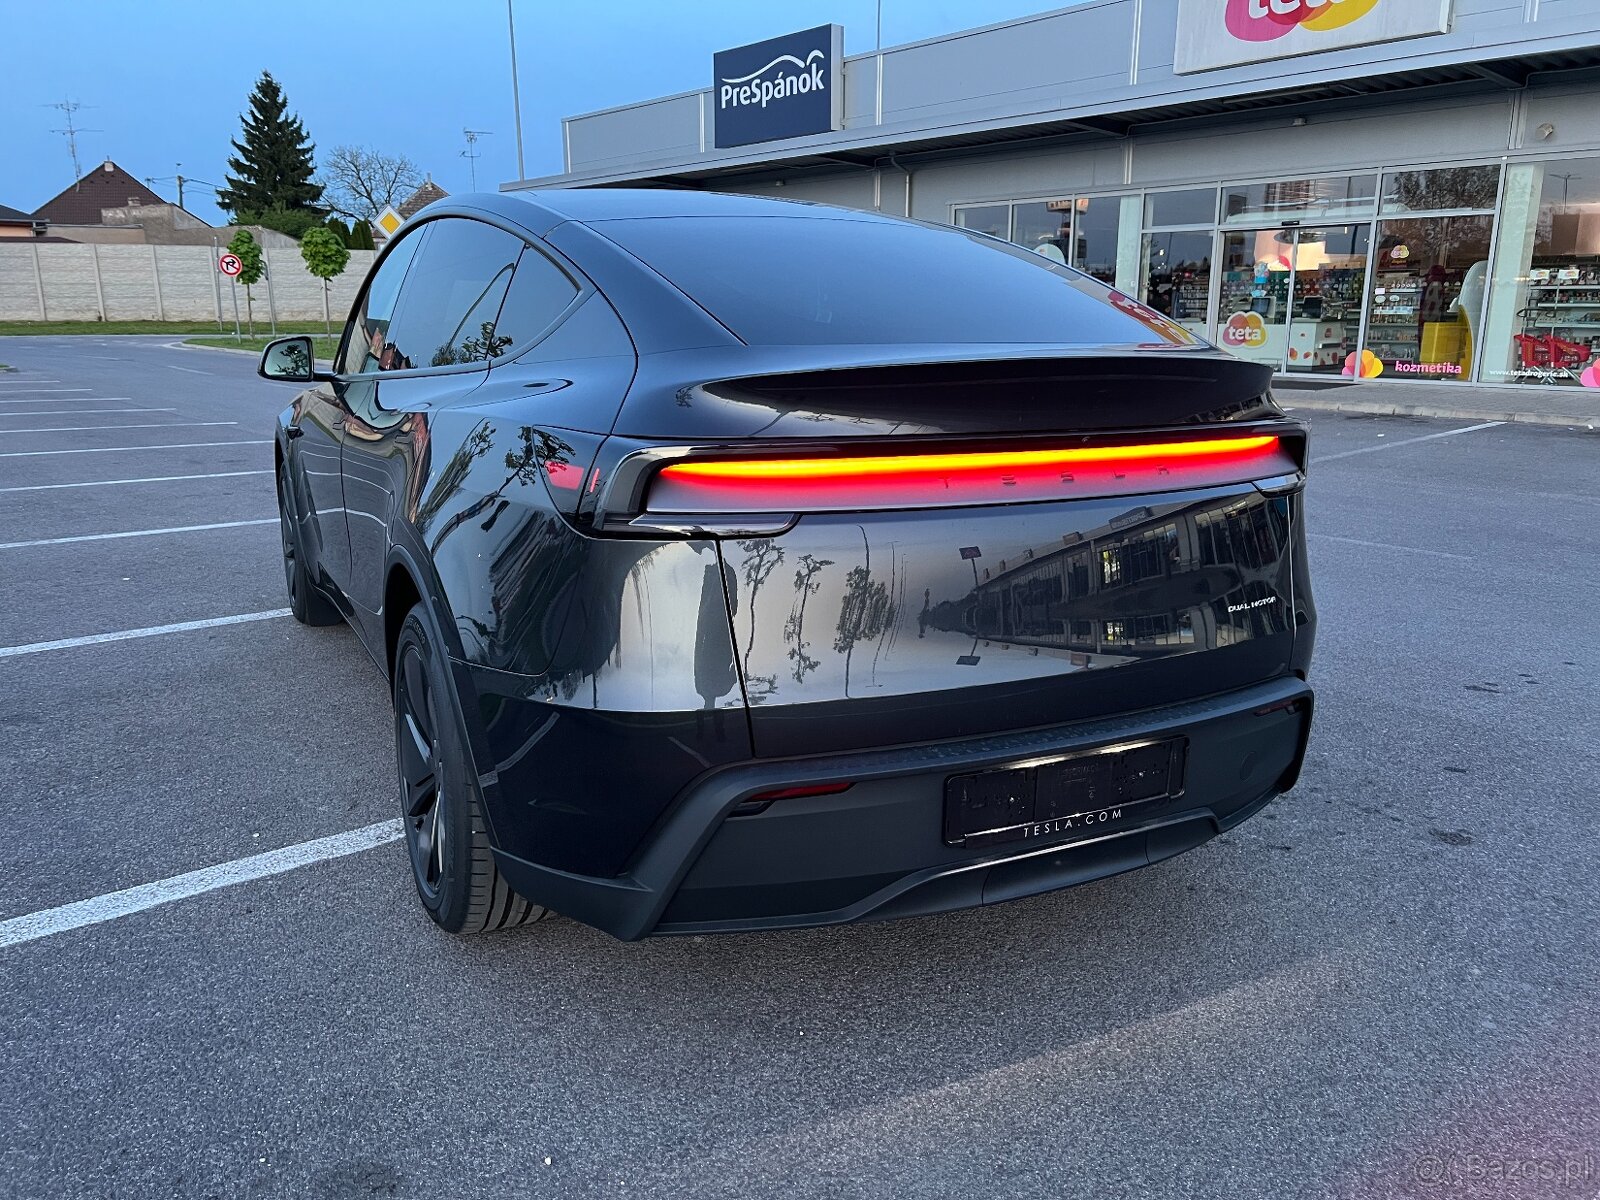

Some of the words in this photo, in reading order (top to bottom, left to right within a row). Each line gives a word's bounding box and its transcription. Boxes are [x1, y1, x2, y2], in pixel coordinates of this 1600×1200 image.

[720, 62, 825, 109] PreSpánok
[1228, 325, 1261, 341] teta
[1394, 360, 1462, 374] kozmetika
[1488, 368, 1569, 379] www.tetadrogerie.sk
[1227, 603, 1250, 613] DUAL
[1251, 596, 1277, 608] MOTOR
[1023, 808, 1123, 838] TESLA.COM
